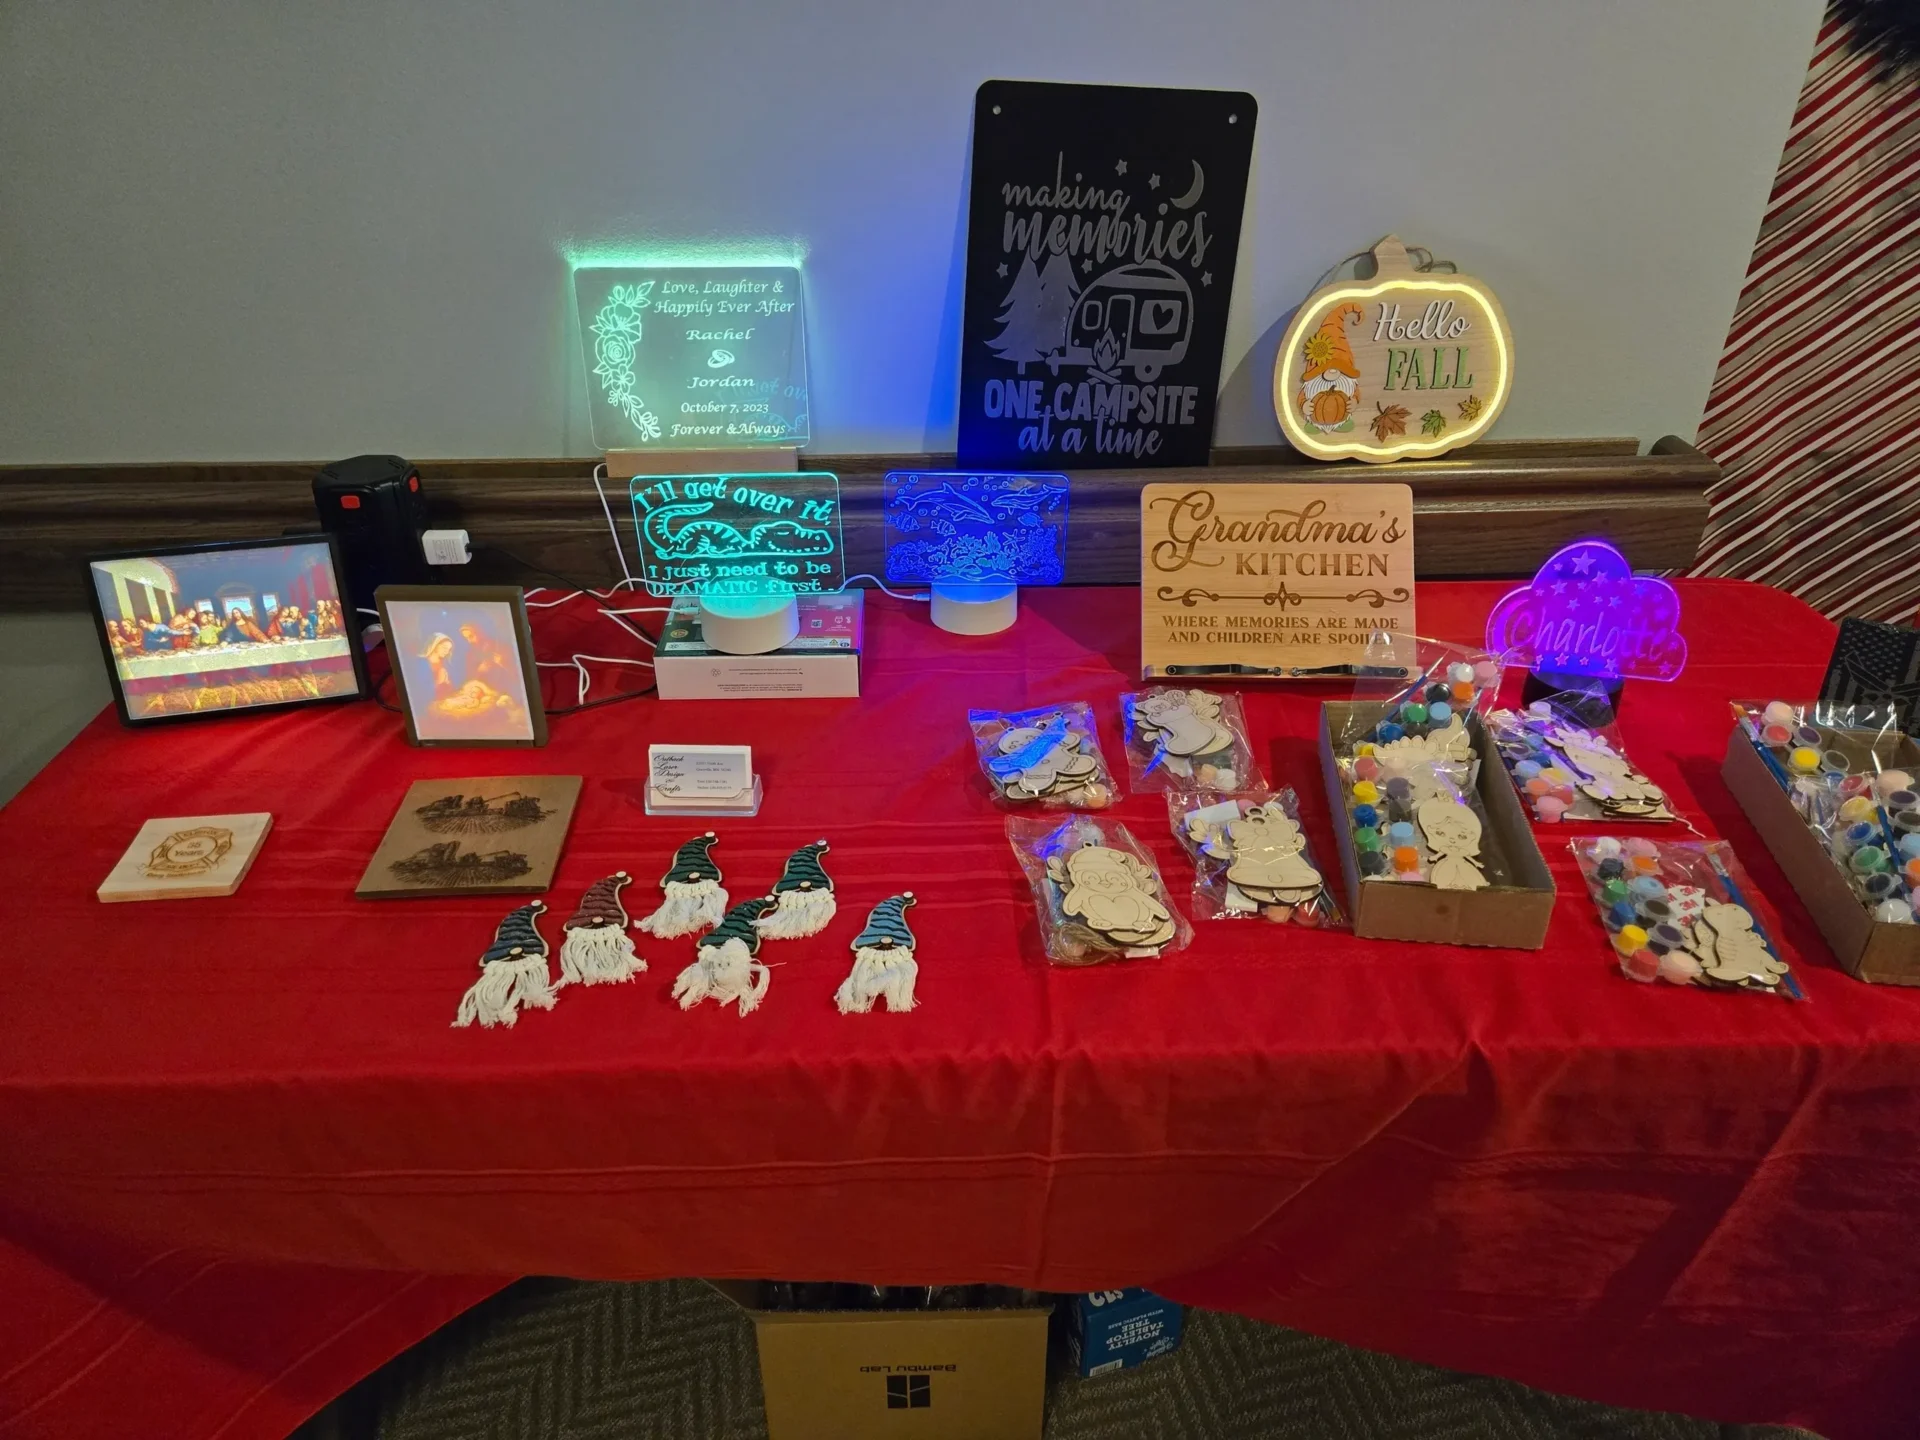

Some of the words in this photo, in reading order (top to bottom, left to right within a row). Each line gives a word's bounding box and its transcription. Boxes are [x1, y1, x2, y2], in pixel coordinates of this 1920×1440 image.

[1002, 151, 1130, 249] making
[1003, 203, 1213, 267] memories
[661, 281, 699, 295] Love,
[703, 279, 768, 297] Laughter
[772, 280, 784, 293] &
[654, 299, 713, 317] Happily
[718, 300, 751, 313] Ever
[755, 299, 795, 316] After
[1373, 299, 1471, 341] Hello
[685, 328, 755, 340] Rachel
[1384, 346, 1474, 391] FALL
[687, 376, 755, 389] Jordan
[681, 401, 727, 413] October
[729, 404, 740, 413] 7,
[743, 404, 769, 413] 2023
[984, 379, 1043, 420] ONE
[1054, 382, 1198, 424] CAMPSITE
[670, 423, 723, 437] Forever
[1018, 405, 1055, 452] at
[1061, 427, 1087, 453] a
[1093, 407, 1163, 458] time
[634, 480, 678, 513] I'll
[684, 476, 729, 499] get
[733, 487, 794, 514] over
[1149, 490, 1407, 572] Grandma's
[648, 565, 658, 578] I
[662, 562, 712, 581] just
[716, 561, 768, 577] need
[773, 561, 799, 575] to
[805, 561, 832, 574] be
[1235, 552, 1390, 577] KITCHEN
[652, 580, 758, 595] DRAMATIC
[1162, 615, 1218, 628] WHERE
[1225, 616, 1309, 629] MEMORIES
[1316, 617, 1347, 629] ARE
[1354, 617, 1399, 629] MADE
[1168, 631, 1200, 643] AND
[1206, 632, 1284, 644] CHILDREN
[1290, 632, 1321, 645] ARE
[1106, 1321, 1164, 1344] TABLETOP
[1122, 1318, 1150, 1332] TREE
[1108, 1330, 1160, 1351] NOVELTY
[860, 1365, 891, 1373] Lab
[896, 1364, 957, 1373] Bambu
